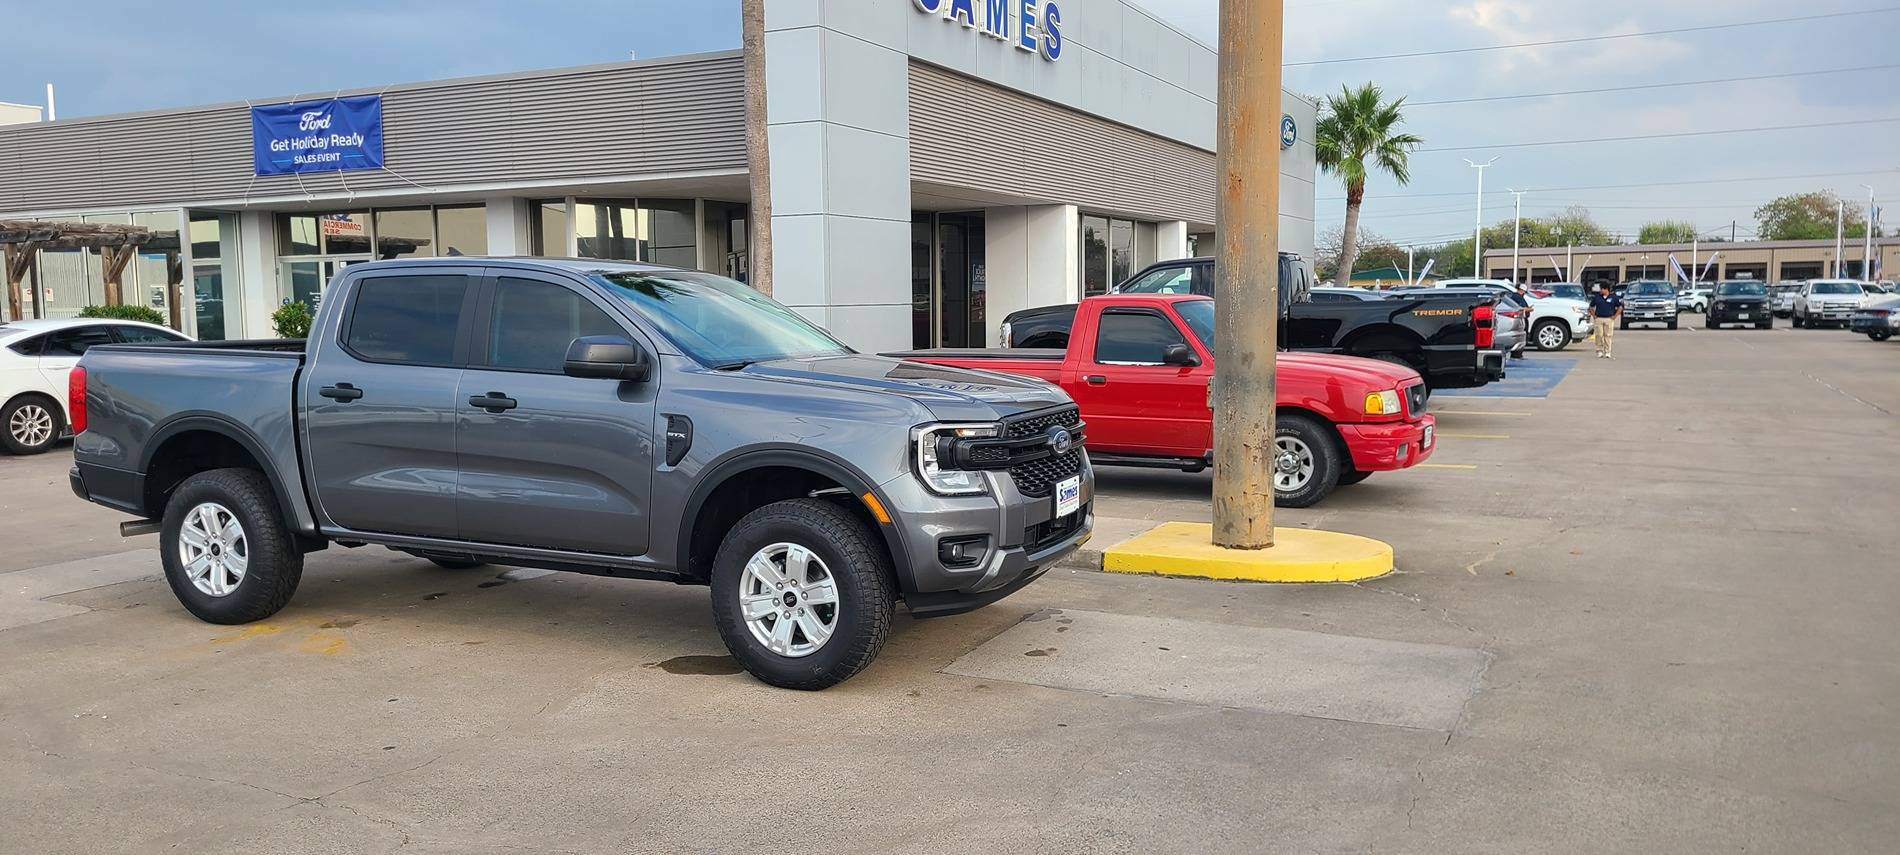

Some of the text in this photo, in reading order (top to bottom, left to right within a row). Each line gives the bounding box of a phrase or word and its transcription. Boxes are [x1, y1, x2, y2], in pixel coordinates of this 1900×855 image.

[914, 0, 1062, 62] AMES
[299, 111, 332, 131] Ford
[270, 132, 365, 152] Get Holiday Ready
[294, 153, 341, 164] SALES EVENT
